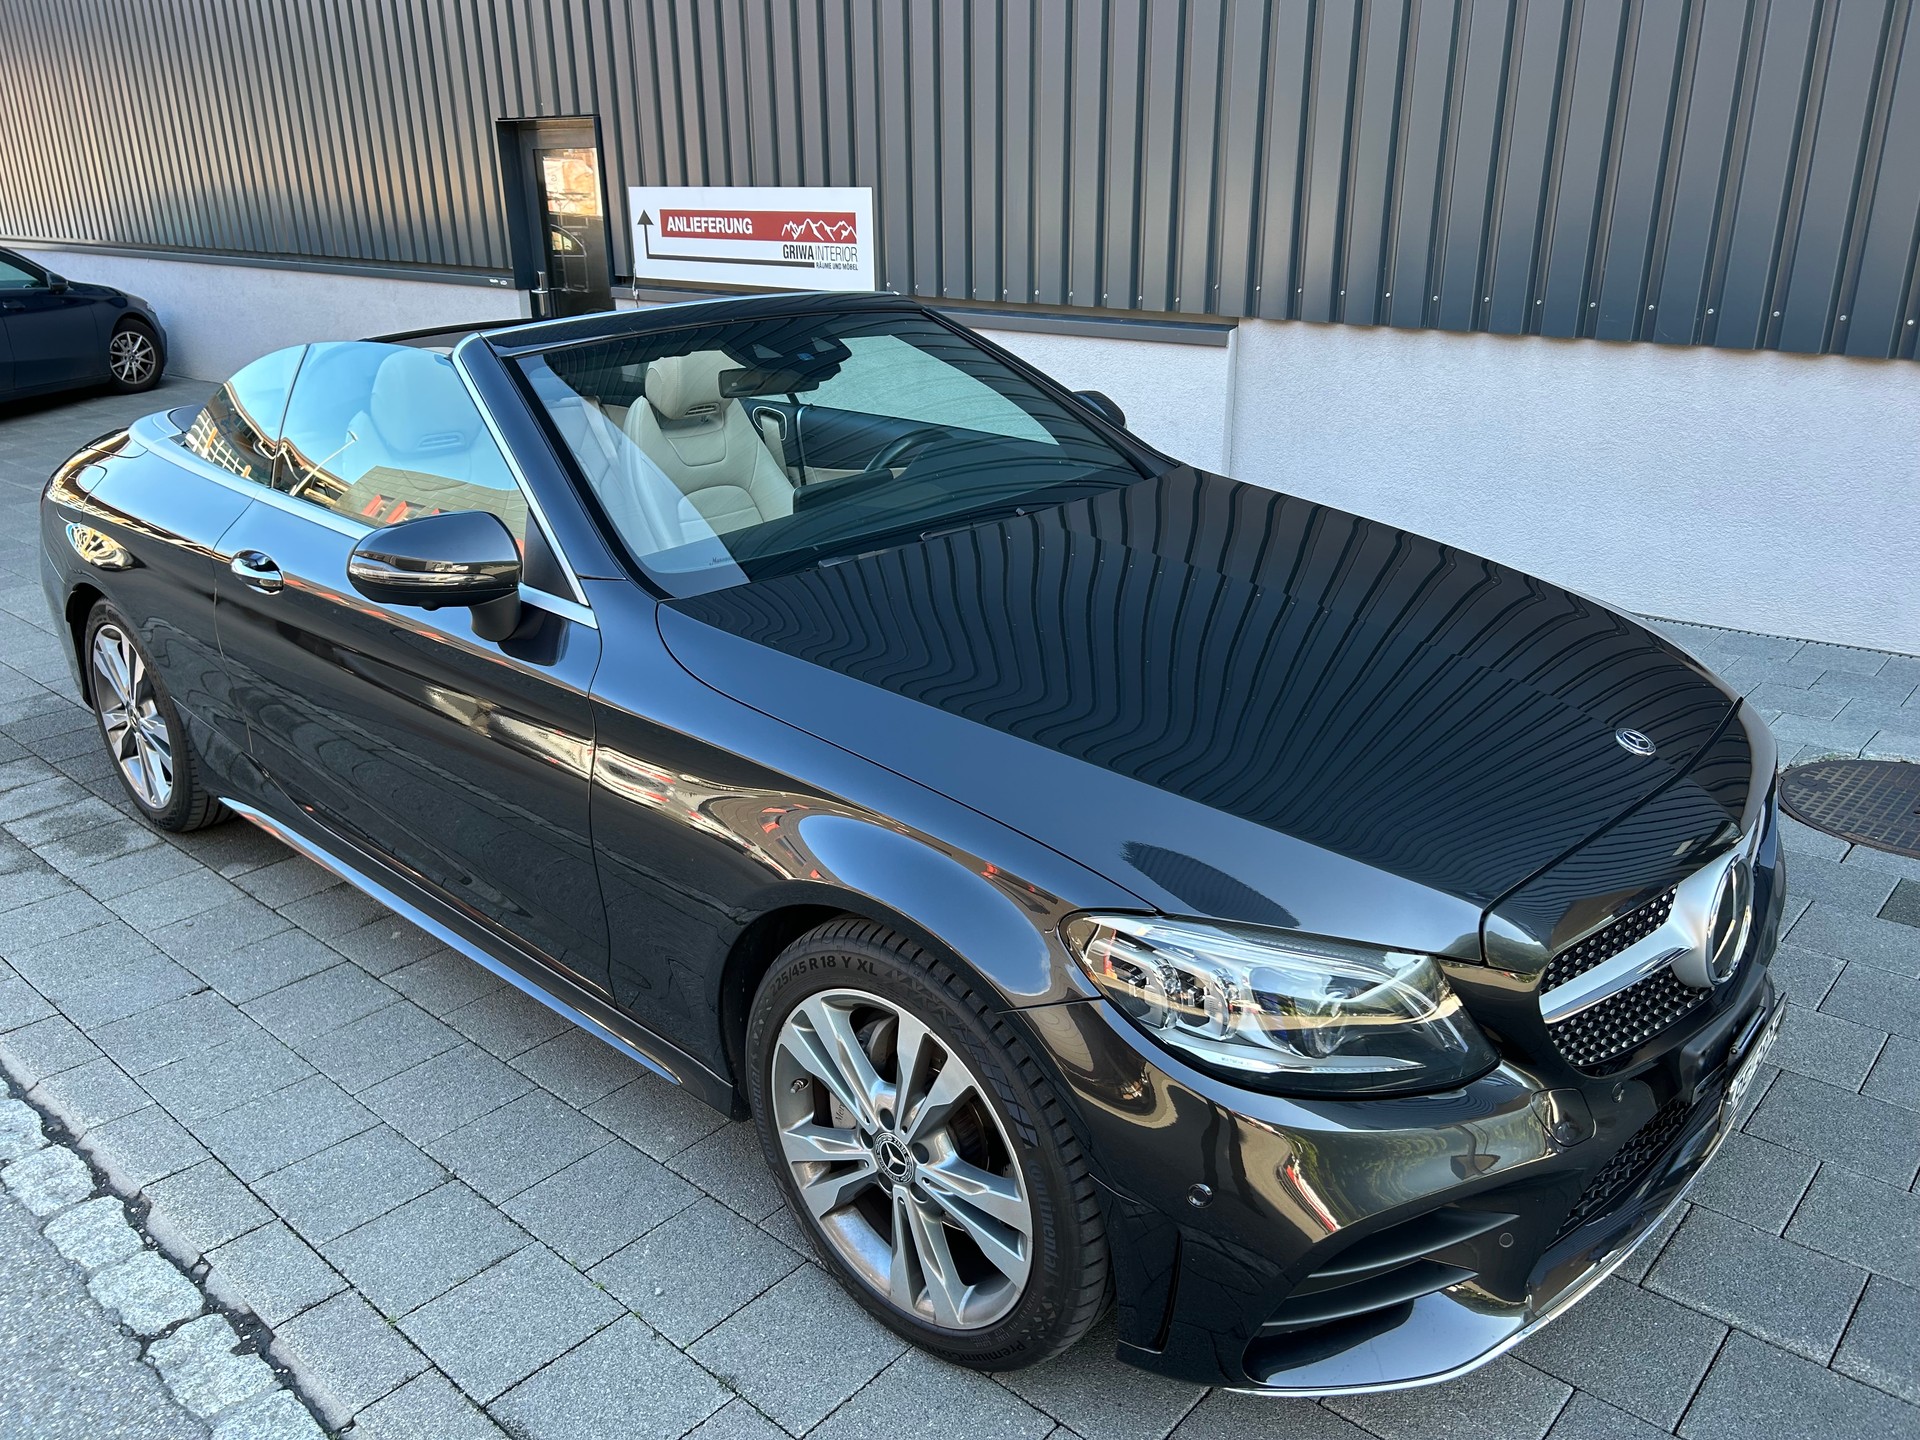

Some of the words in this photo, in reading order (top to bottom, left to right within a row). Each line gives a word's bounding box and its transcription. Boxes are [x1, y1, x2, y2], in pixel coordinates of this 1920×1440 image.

[666, 216, 753, 234] ANLIEFERUNG
[770, 961, 808, 996] 225/45
[841, 955, 852, 969] Y
[857, 958, 878, 977] XL
